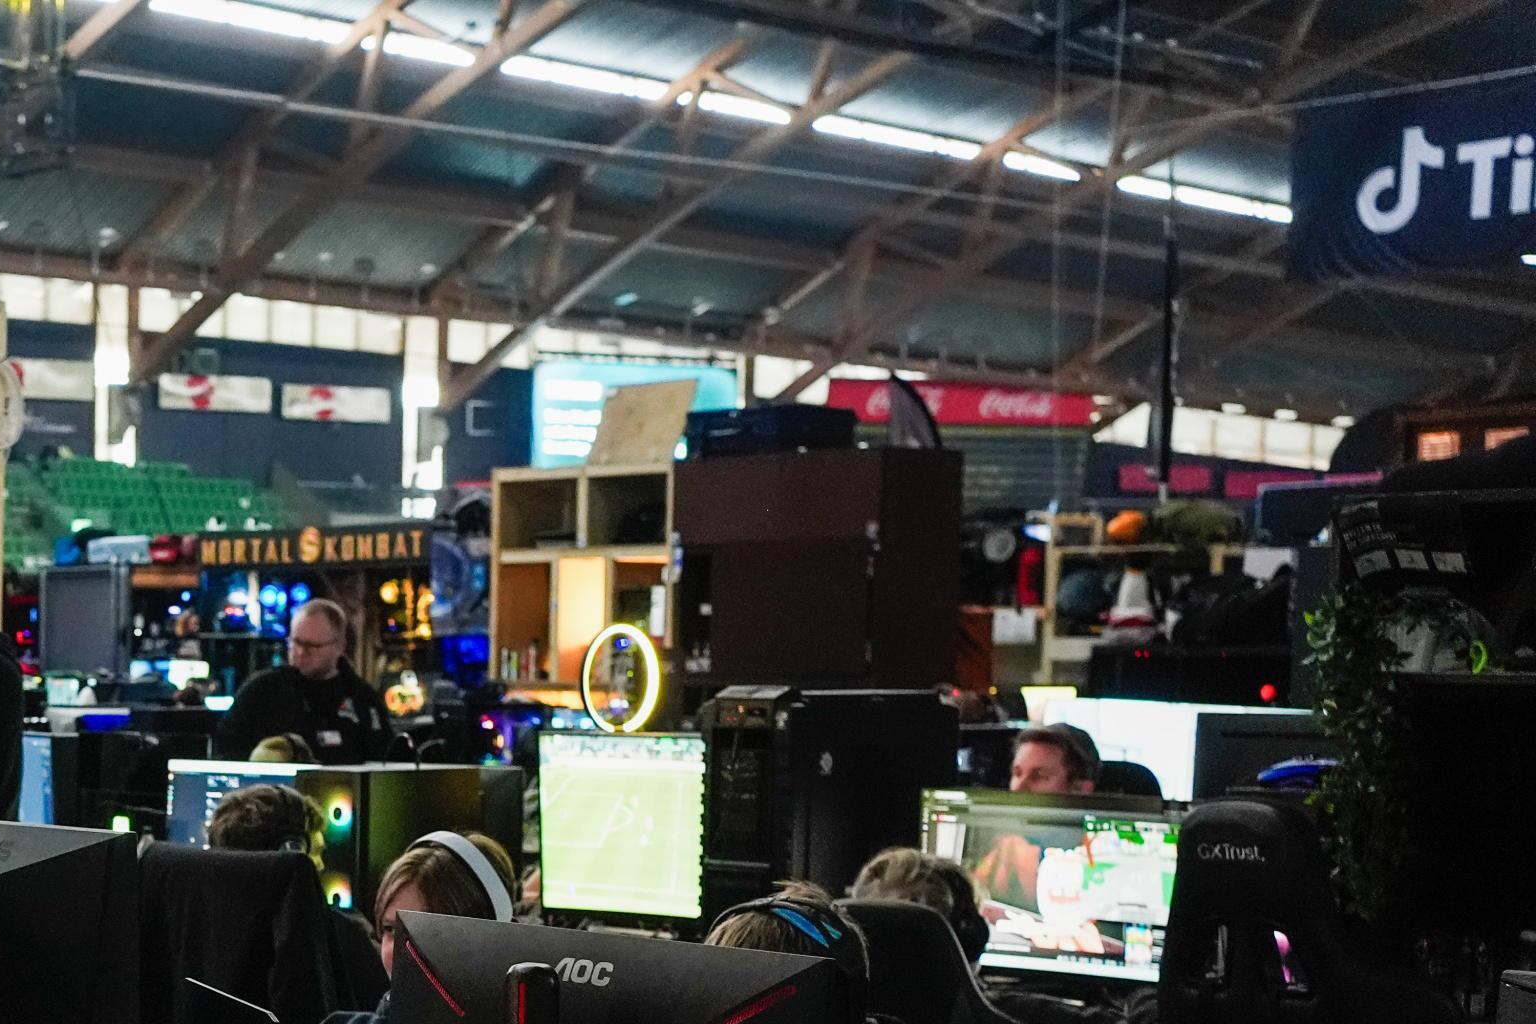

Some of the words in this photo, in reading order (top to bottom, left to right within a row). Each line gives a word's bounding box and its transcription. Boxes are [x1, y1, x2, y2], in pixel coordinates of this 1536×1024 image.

[200, 536, 293, 566] MORTAL
[324, 529, 423, 562] KOMBAT
[554, 957, 615, 987] AOC
